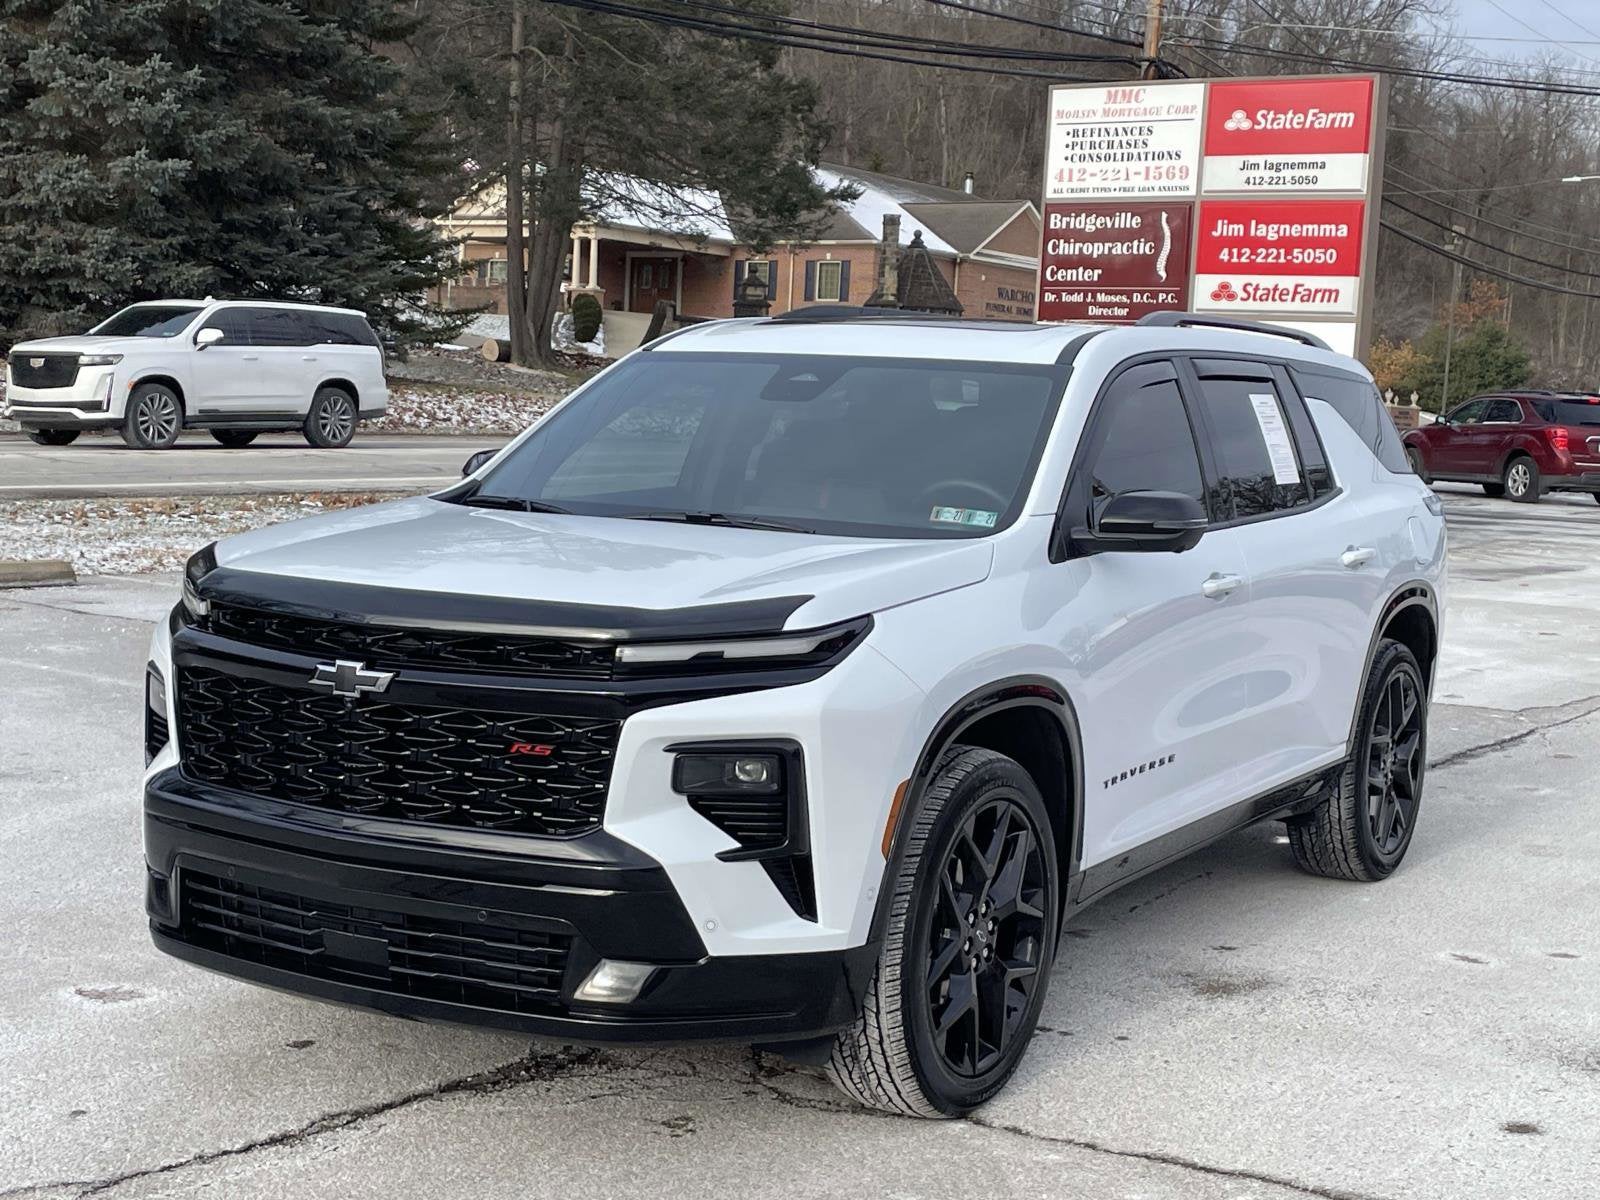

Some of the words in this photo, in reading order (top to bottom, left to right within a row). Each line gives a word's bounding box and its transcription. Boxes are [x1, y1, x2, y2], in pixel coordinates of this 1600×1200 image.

[1104, 88, 1146, 104] MMC
[1101, 106, 1163, 118] MORTGAGE
[1072, 125, 1154, 138] REFINANCES
[1071, 138, 1149, 151] PURCHASES
[1070, 150, 1182, 163] CONSOLIDATIONS
[1239, 160, 1260, 171] Jim
[1055, 165, 1190, 182] 412-221-1569
[1244, 175, 1318, 186] 412-221-5050
[1049, 212, 1142, 233] Bridgeville
[1211, 219, 1244, 238] Jim
[1250, 219, 1348, 241] Iagnemma
[1047, 238, 1155, 258] Chiropractic
[1219, 247, 1337, 264] 412-221-5050
[1045, 265, 1102, 281] Center
[1044, 292, 1059, 302] Dr.
[1061, 292, 1084, 302] Todd
[1085, 292, 1095, 303] J.
[1096, 292, 1130, 304] Moses,
[1158, 293, 1178, 303] P.C.
[1088, 305, 1130, 316] Director
[510, 742, 557, 756] RS
[1103, 753, 1176, 789] TRAVERSE
